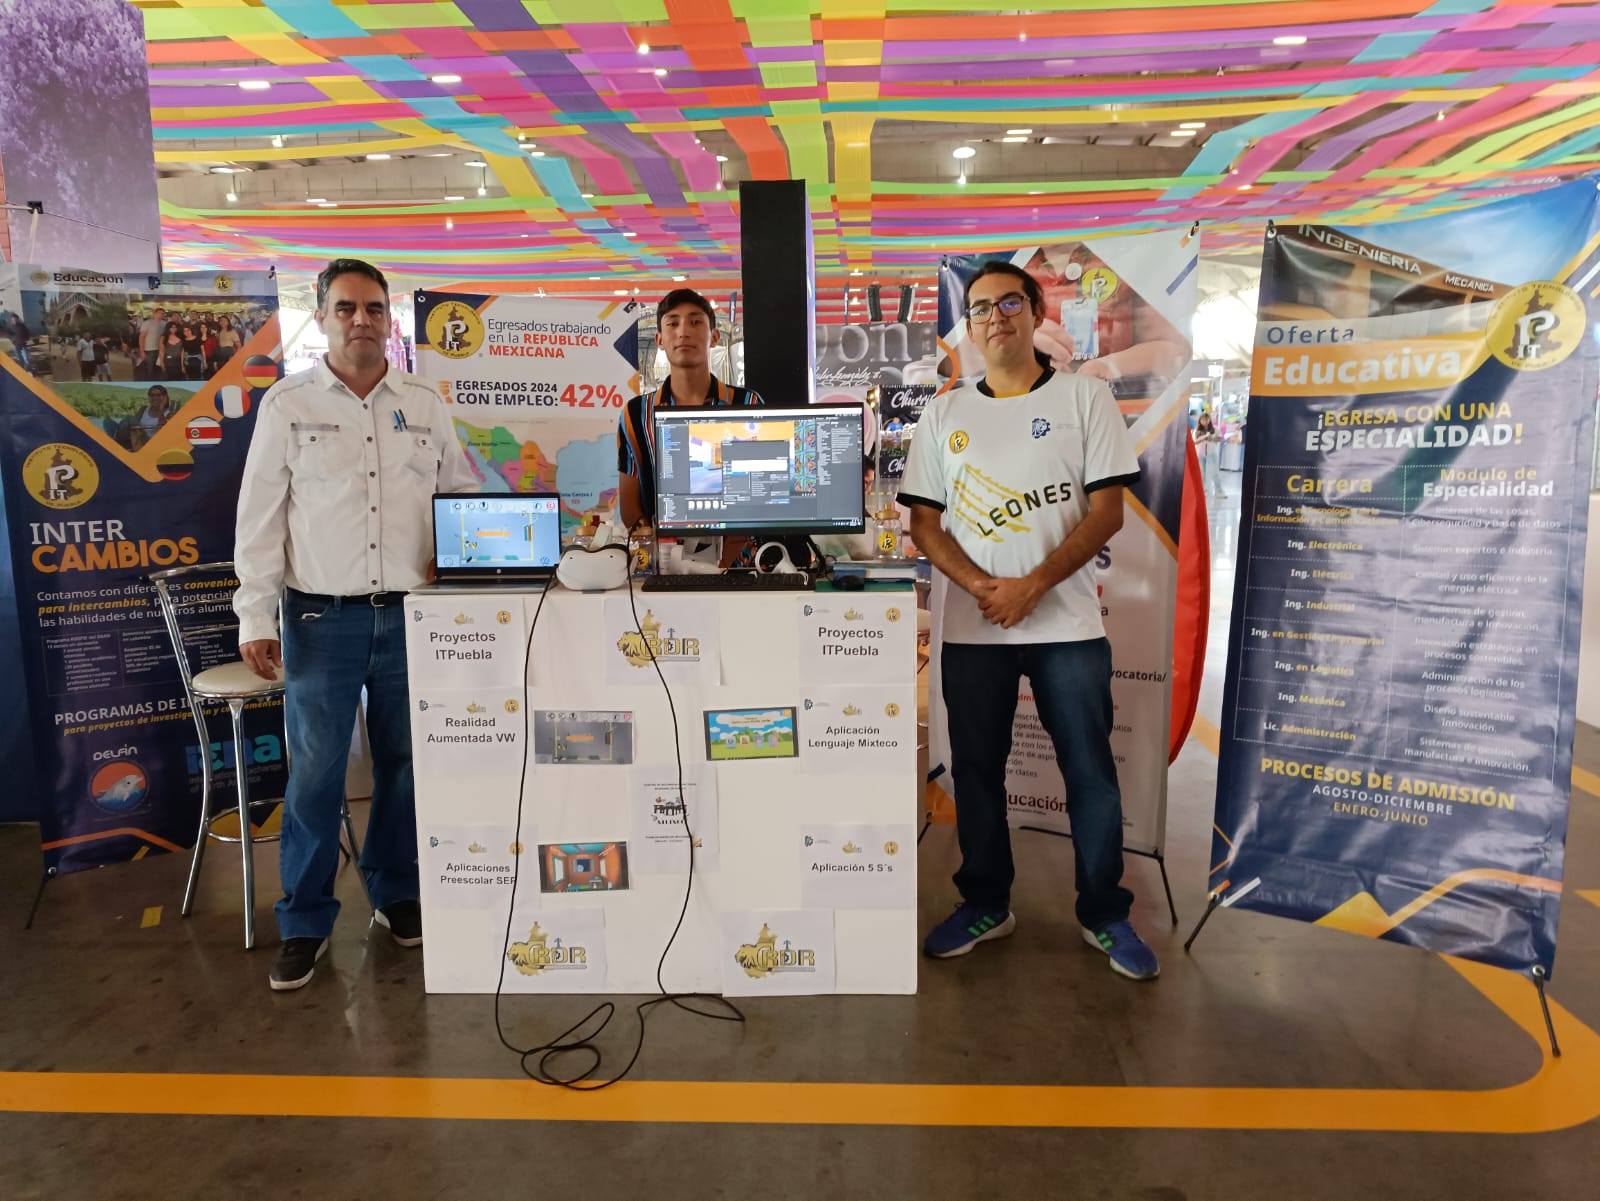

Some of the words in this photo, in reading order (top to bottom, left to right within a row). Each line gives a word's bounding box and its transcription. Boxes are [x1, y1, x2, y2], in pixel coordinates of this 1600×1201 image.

[1298, 224, 1422, 275] INGENIERIA
[1445, 274, 1494, 293] MECANICA
[488, 318, 548, 333] Egresados
[550, 321, 611, 336] trabajando
[1267, 325, 1355, 344] Oferta
[488, 333, 503, 343] en
[508, 331, 519, 343] la
[488, 344, 565, 358] MEXICANA
[1264, 347, 1461, 386] Educativa
[456, 380, 527, 392] EGRESADOS
[530, 382, 558, 393] 2024
[456, 392, 490, 405] CON
[495, 393, 559, 407] EMPLEO:
[560, 383, 624, 408] 42%
[1317, 406, 1398, 430] ¡EGRESA
[1405, 403, 1451, 423] CON
[1459, 401, 1512, 420] UNA
[1305, 422, 1523, 451] ESPECIALIDAD!
[1515, 467, 1537, 481] de
[1286, 474, 1373, 494] Carrera
[1423, 480, 1554, 501] Especialidad
[976, 482, 1072, 537] LEONES
[1277, 504, 1294, 516] Ing.
[29, 519, 127, 545] INTER
[1287, 539, 1307, 550] Ing.
[31, 536, 200, 573] CAMBIOS
[1290, 568, 1310, 579] Ing.
[37, 589, 97, 602] Contamos
[100, 587, 121, 597] con
[184, 578, 240, 590] convenios
[38, 605, 65, 617] para
[182, 591, 235, 604] potenciali
[1284, 599, 1304, 610] Ing.
[39, 617, 56, 628] las
[59, 611, 127, 627] habilidades
[129, 609, 144, 620] de
[199, 603, 234, 615] alumn
[429, 631, 496, 645] Proyectos
[818, 626, 884, 641] Proyectos
[1251, 627, 1271, 639] Ing.
[435, 649, 493, 660] ITPuebla
[822, 644, 880, 656] ITPuebla
[1274, 660, 1294, 672] Ing.
[1495, 677, 1509, 686] de
[1510, 679, 1525, 689] los
[1278, 692, 1297, 704] Ing.
[54, 701, 154, 726] PROGRAMAS
[158, 698, 177, 712] DE
[63, 726, 86, 737] para
[88, 718, 135, 734] proyectos
[137, 715, 149, 725] de
[445, 717, 496, 728] Realidad
[427, 733, 493, 744] Aumentada
[496, 733, 516, 743] VW
[826, 725, 880, 737] Aplicación
[1263, 722, 1280, 731] Lic.
[1281, 724, 1357, 741] Administración
[808, 738, 855, 749] Lenguaje
[858, 738, 898, 749] Mixteco
[1260, 757, 1363, 786] PROCESOS
[1367, 771, 1393, 791] DE
[1397, 777, 1517, 811] ADMISIÓN
[1312, 784, 1454, 816] AGOSTO-DICIEMBRE
[1333, 801, 1429, 826] ENERO-JUNIO
[446, 862, 511, 873] Aplicaciones
[811, 862, 865, 873] Aplicación
[867, 863, 874, 872] 5
[440, 875, 494, 885] Preescolar
